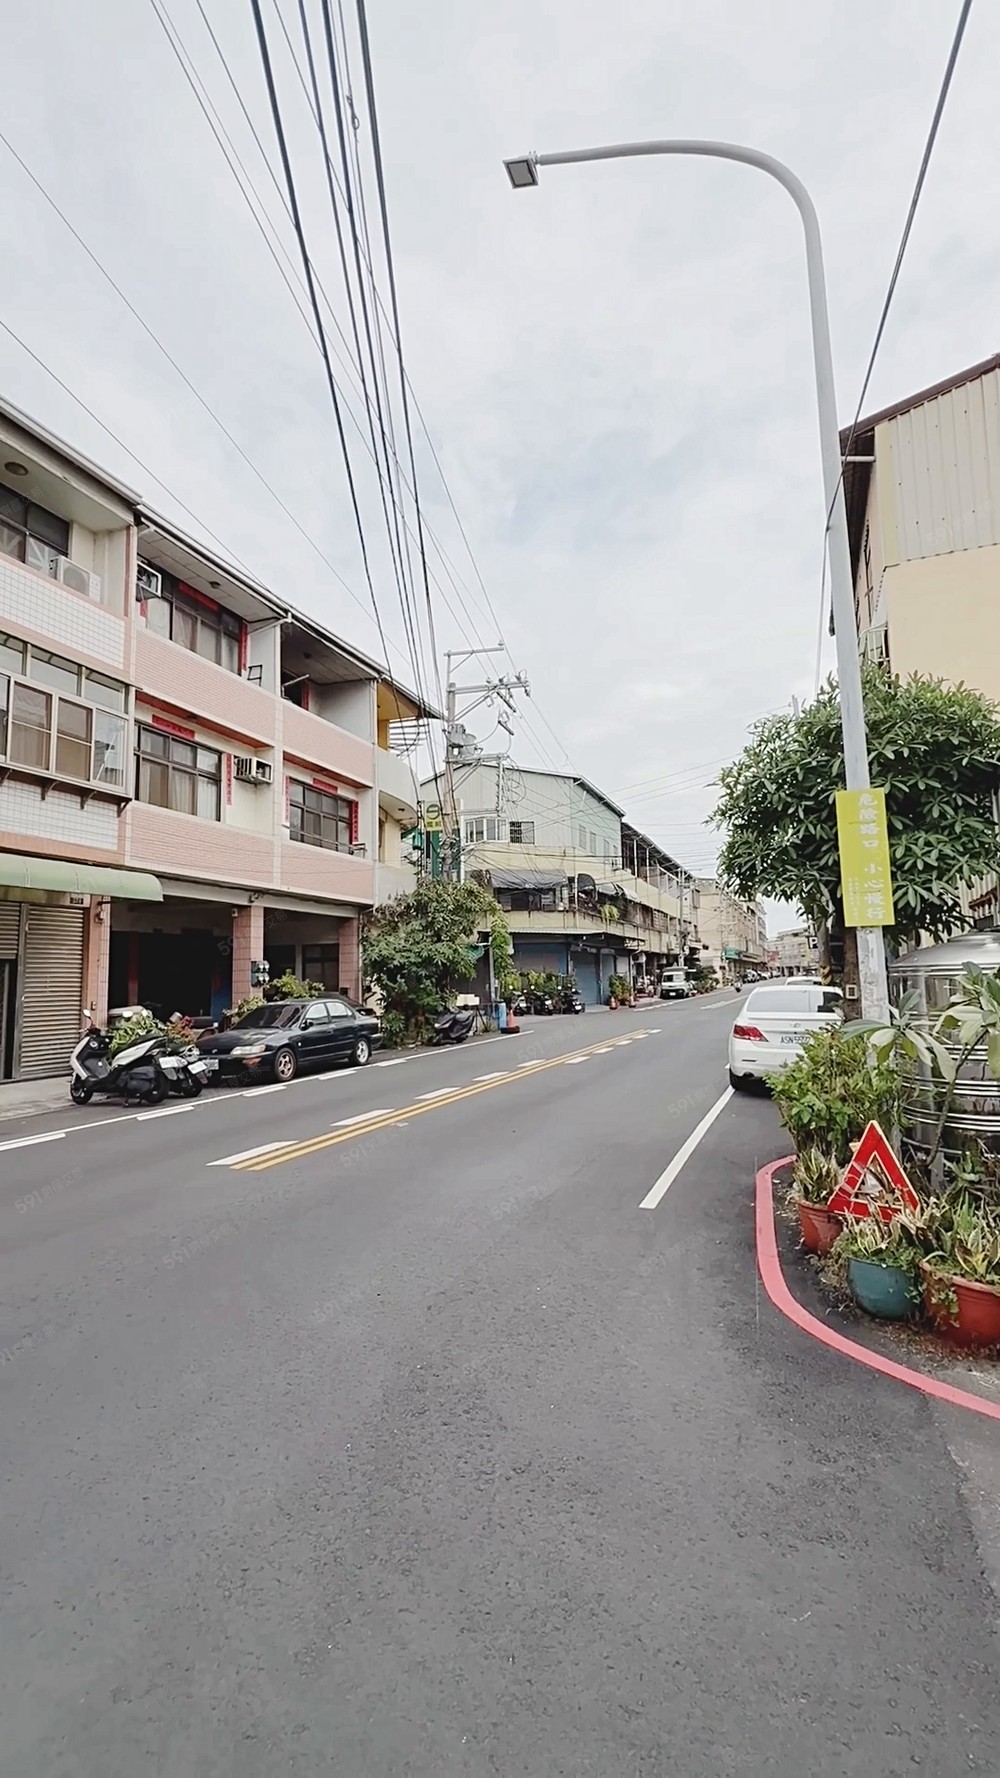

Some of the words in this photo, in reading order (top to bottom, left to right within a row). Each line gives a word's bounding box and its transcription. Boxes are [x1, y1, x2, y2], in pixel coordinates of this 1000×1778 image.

[859, 793, 879, 848] 危險路口
[864, 863, 886, 920] 小心慢行
[809, 937, 818, 949] P
